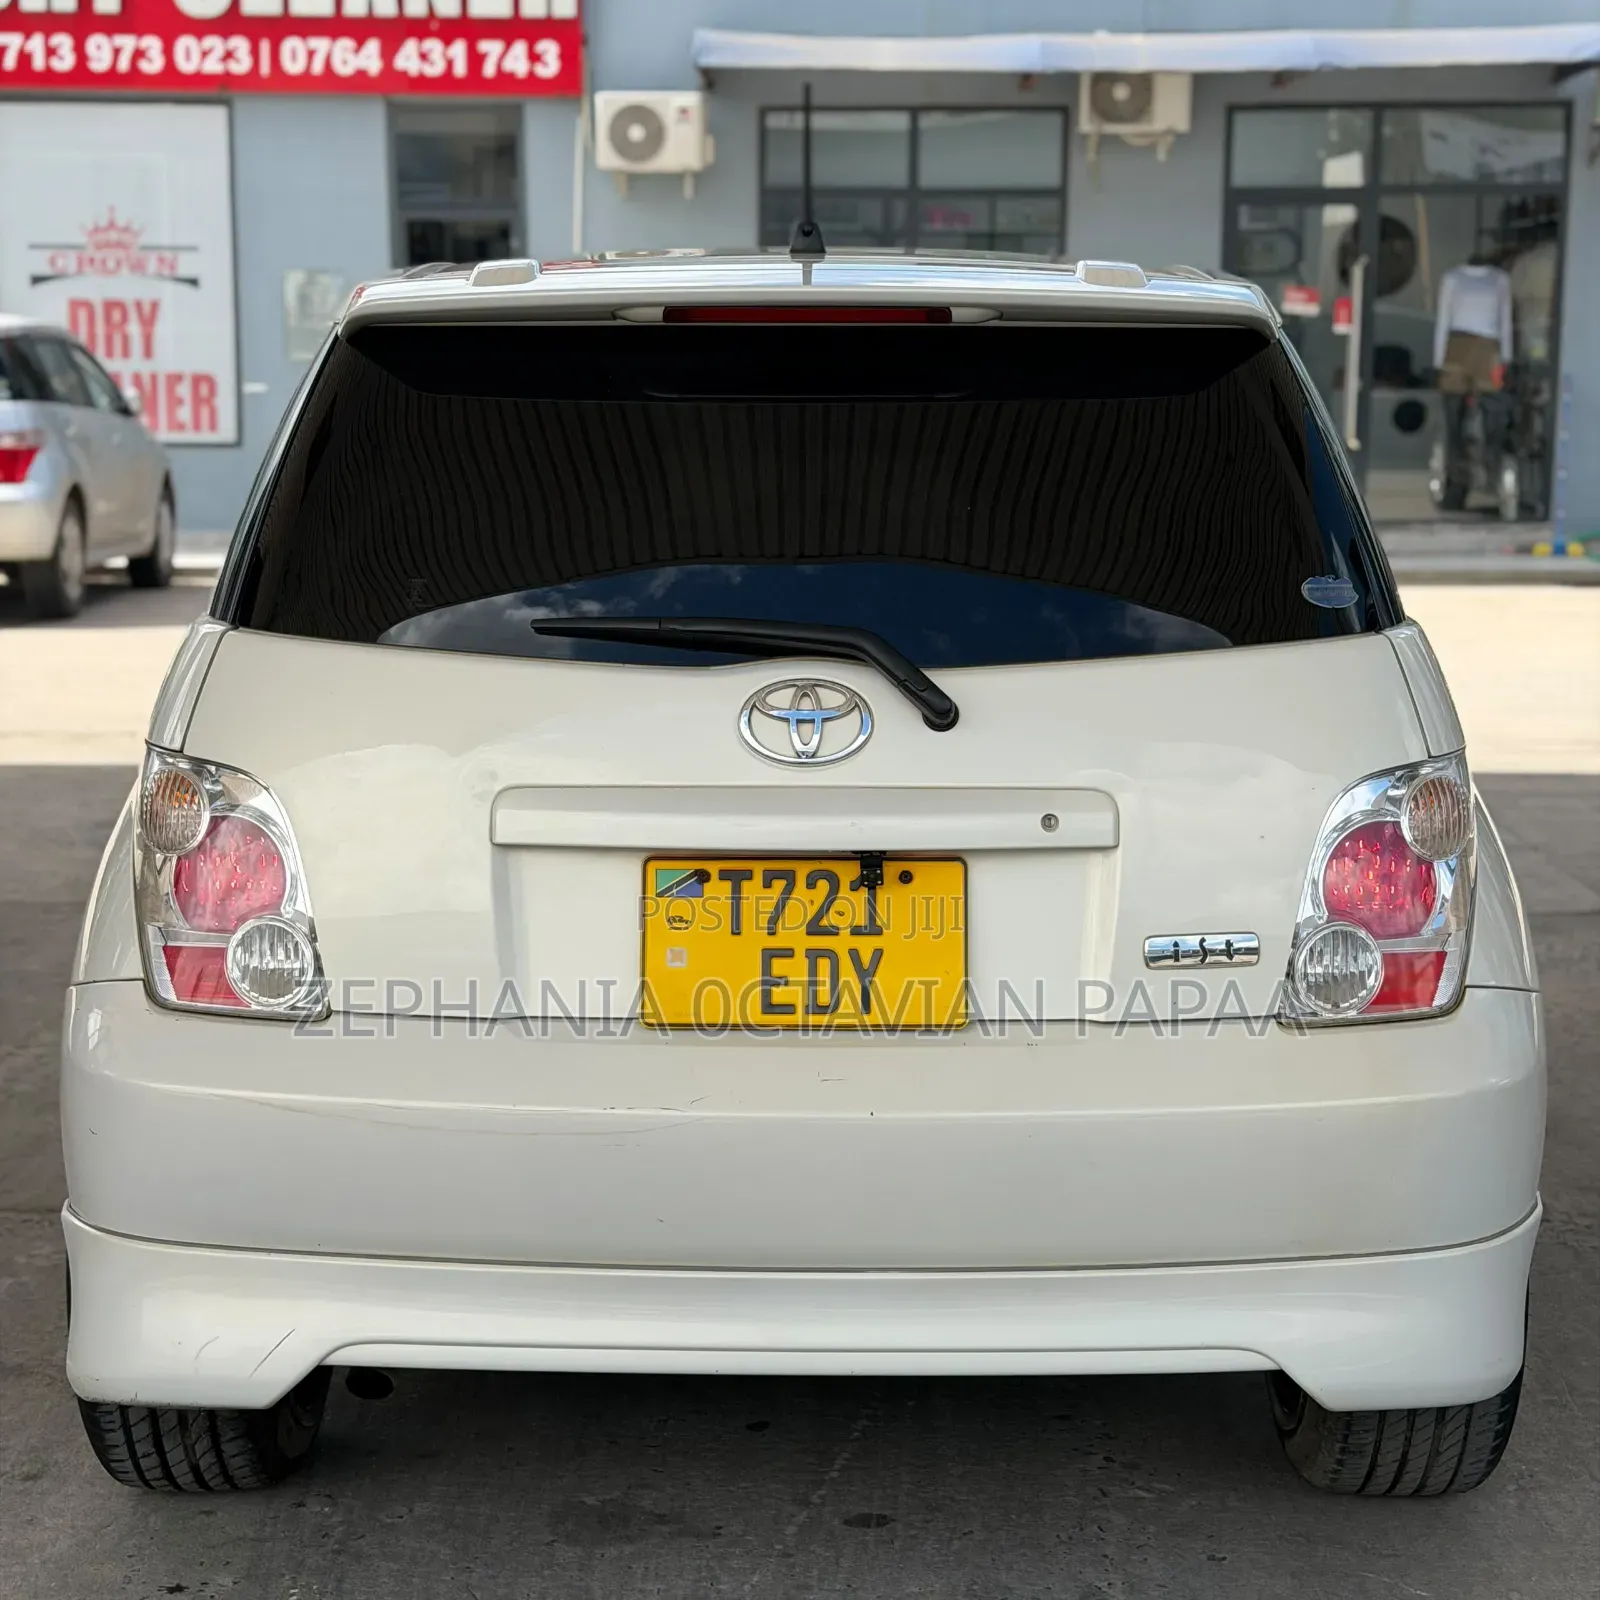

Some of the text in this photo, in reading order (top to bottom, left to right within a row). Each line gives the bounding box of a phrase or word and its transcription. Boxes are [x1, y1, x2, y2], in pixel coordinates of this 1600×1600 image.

[0, 31, 77, 73] 713
[84, 32, 166, 75] 973
[173, 34, 253, 75] 023
[279, 35, 383, 77] 0764
[393, 36, 467, 78] 431
[477, 38, 562, 79] 743
[48, 252, 179, 277] CROWN
[68, 299, 161, 360] DRY
[718, 868, 883, 936] T721
[760, 947, 884, 1015] EDY
